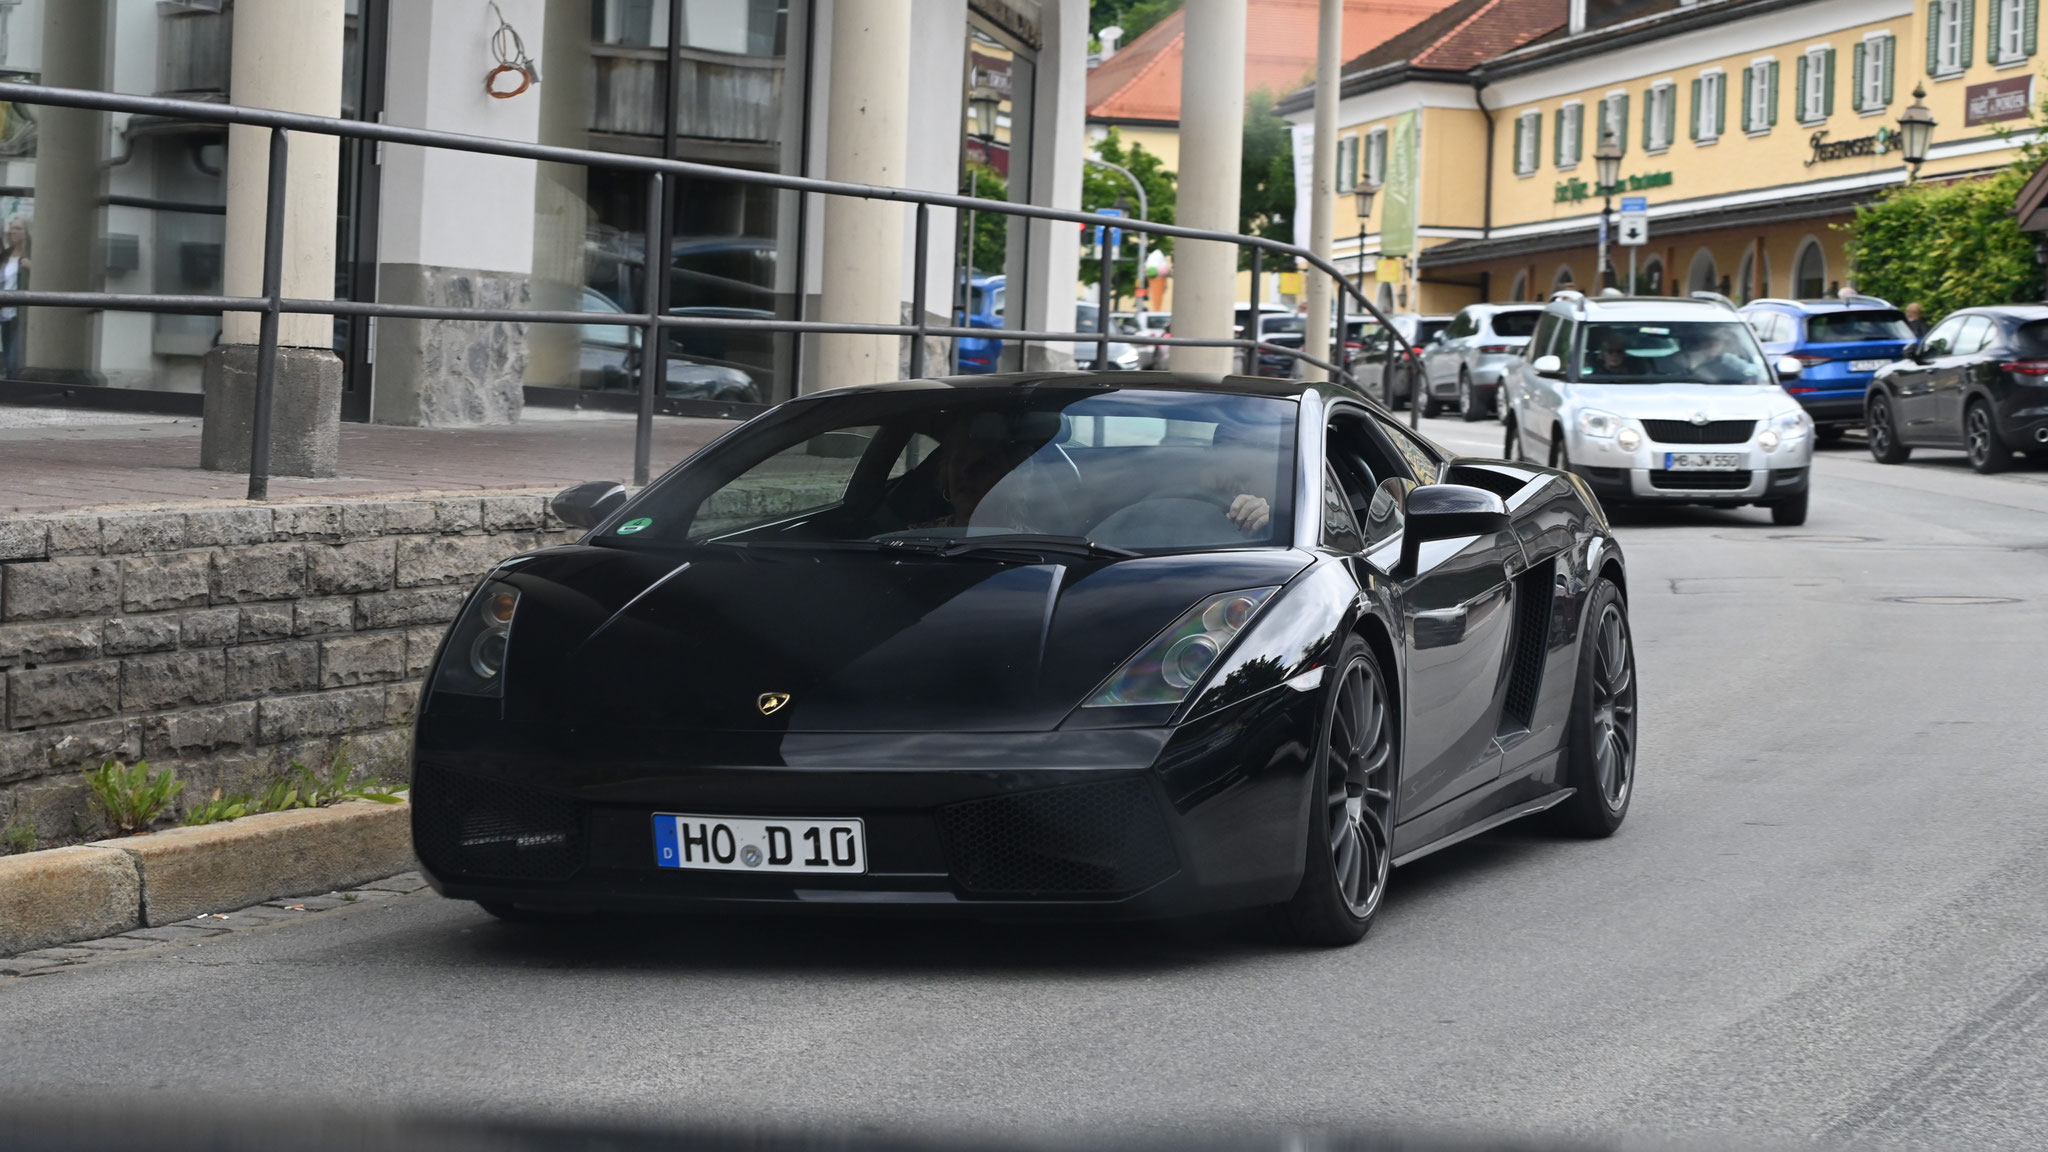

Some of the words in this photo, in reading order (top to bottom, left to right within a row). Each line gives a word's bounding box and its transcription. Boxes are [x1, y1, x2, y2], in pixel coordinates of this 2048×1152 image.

[663, 847, 673, 859] D
[682, 822, 736, 864] HO
[765, 826, 793, 866] D
[803, 827, 857, 867] 10
